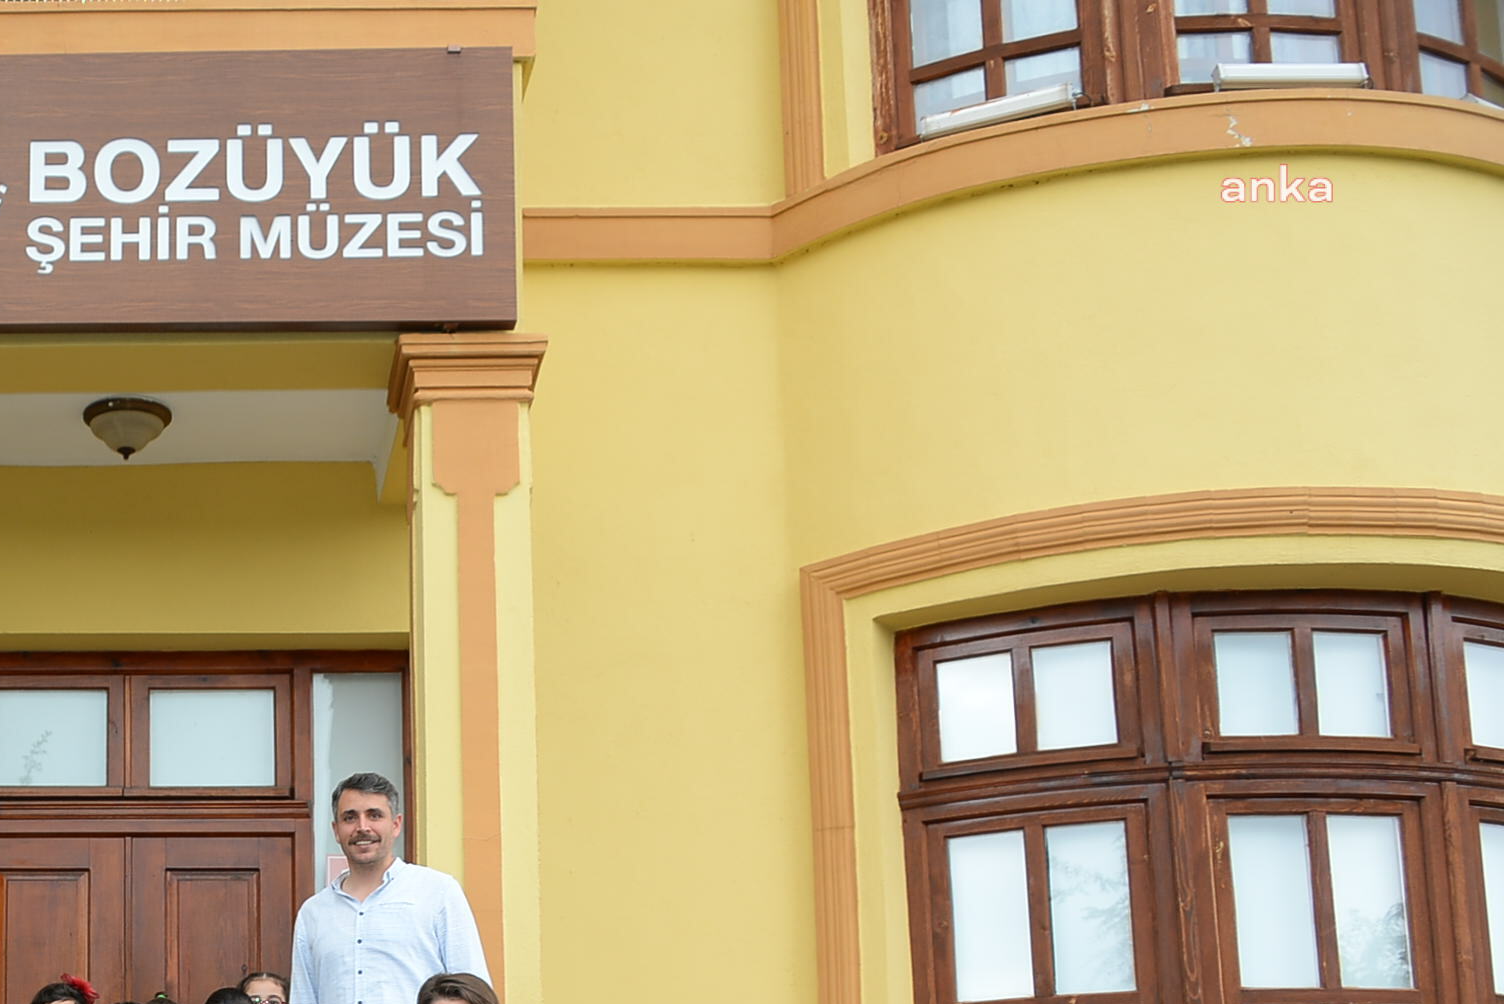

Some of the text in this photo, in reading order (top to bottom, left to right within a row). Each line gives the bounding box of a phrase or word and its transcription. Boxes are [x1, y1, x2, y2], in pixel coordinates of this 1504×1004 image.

[27, 121, 483, 205] BOZÜYÜK
[25, 199, 485, 275] ŞEHİR MÜZESİ
